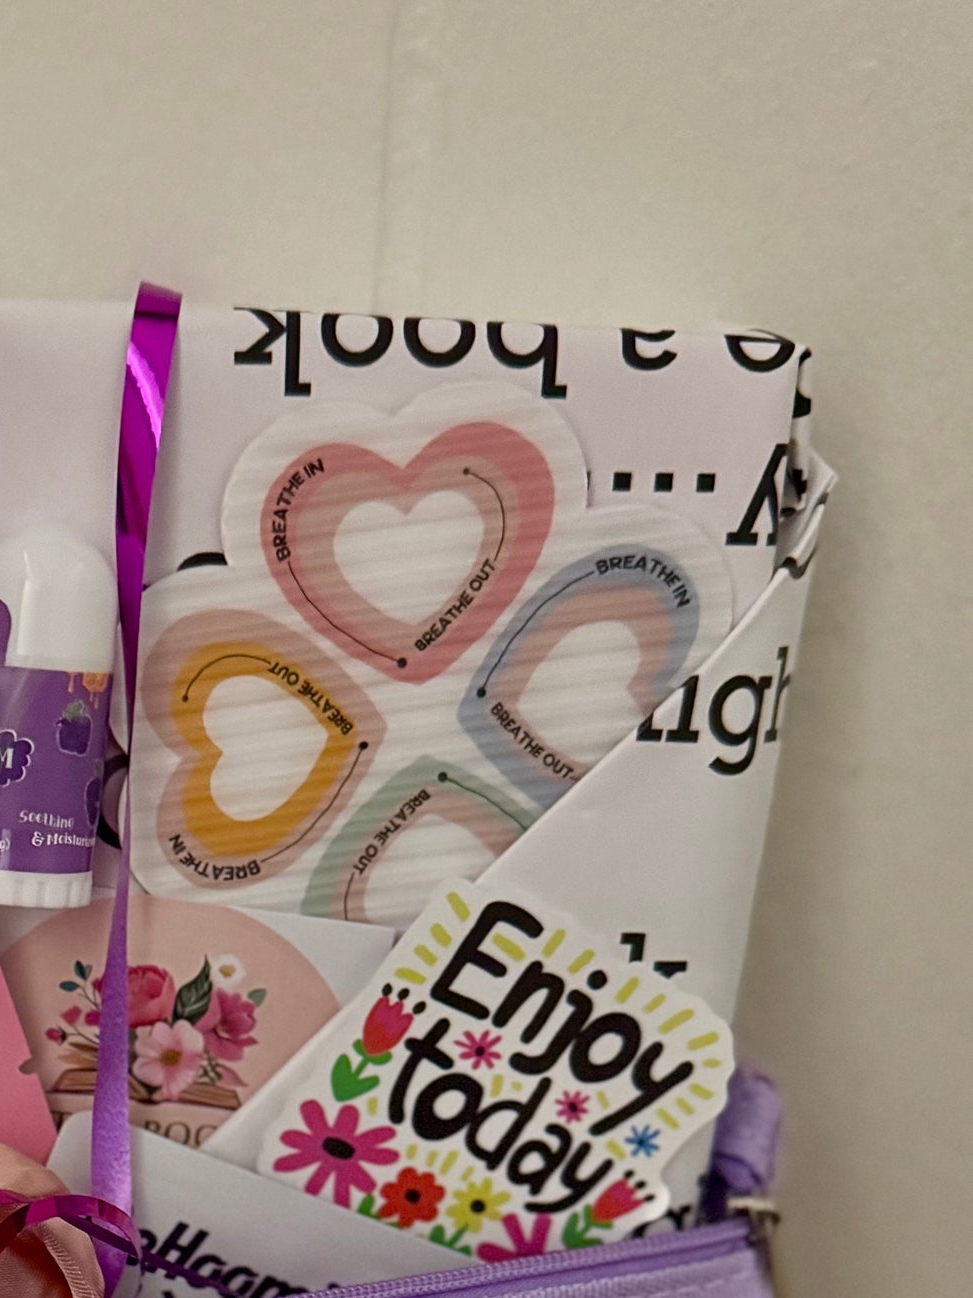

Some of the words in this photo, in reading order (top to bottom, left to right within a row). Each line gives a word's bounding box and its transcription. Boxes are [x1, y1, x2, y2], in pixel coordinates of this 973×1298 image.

[233, 307, 568, 400] book
[271, 473, 305, 563] BREATHE
[303, 457, 325, 480] IN
[413, 590, 474, 652] BREATHE
[468, 558, 497, 593] OUT
[594, 554, 679, 589] BREATHE
[671, 584, 691, 609] IN
[267, 661, 299, 686] OUT
[296, 680, 354, 736] BREATHE
[490, 702, 546, 758] BREATHE
[542, 751, 575, 782] OUT
[17, 809, 75, 830] Soothing
[31, 831, 45, 847] &
[167, 833, 189, 856] IN
[374, 788, 432, 845] BREATHE
[178, 853, 263, 882] BREATHE
[352, 846, 379, 877] OUT
[430, 901, 694, 1136] Enjoy
[388, 1017, 614, 1214] today
